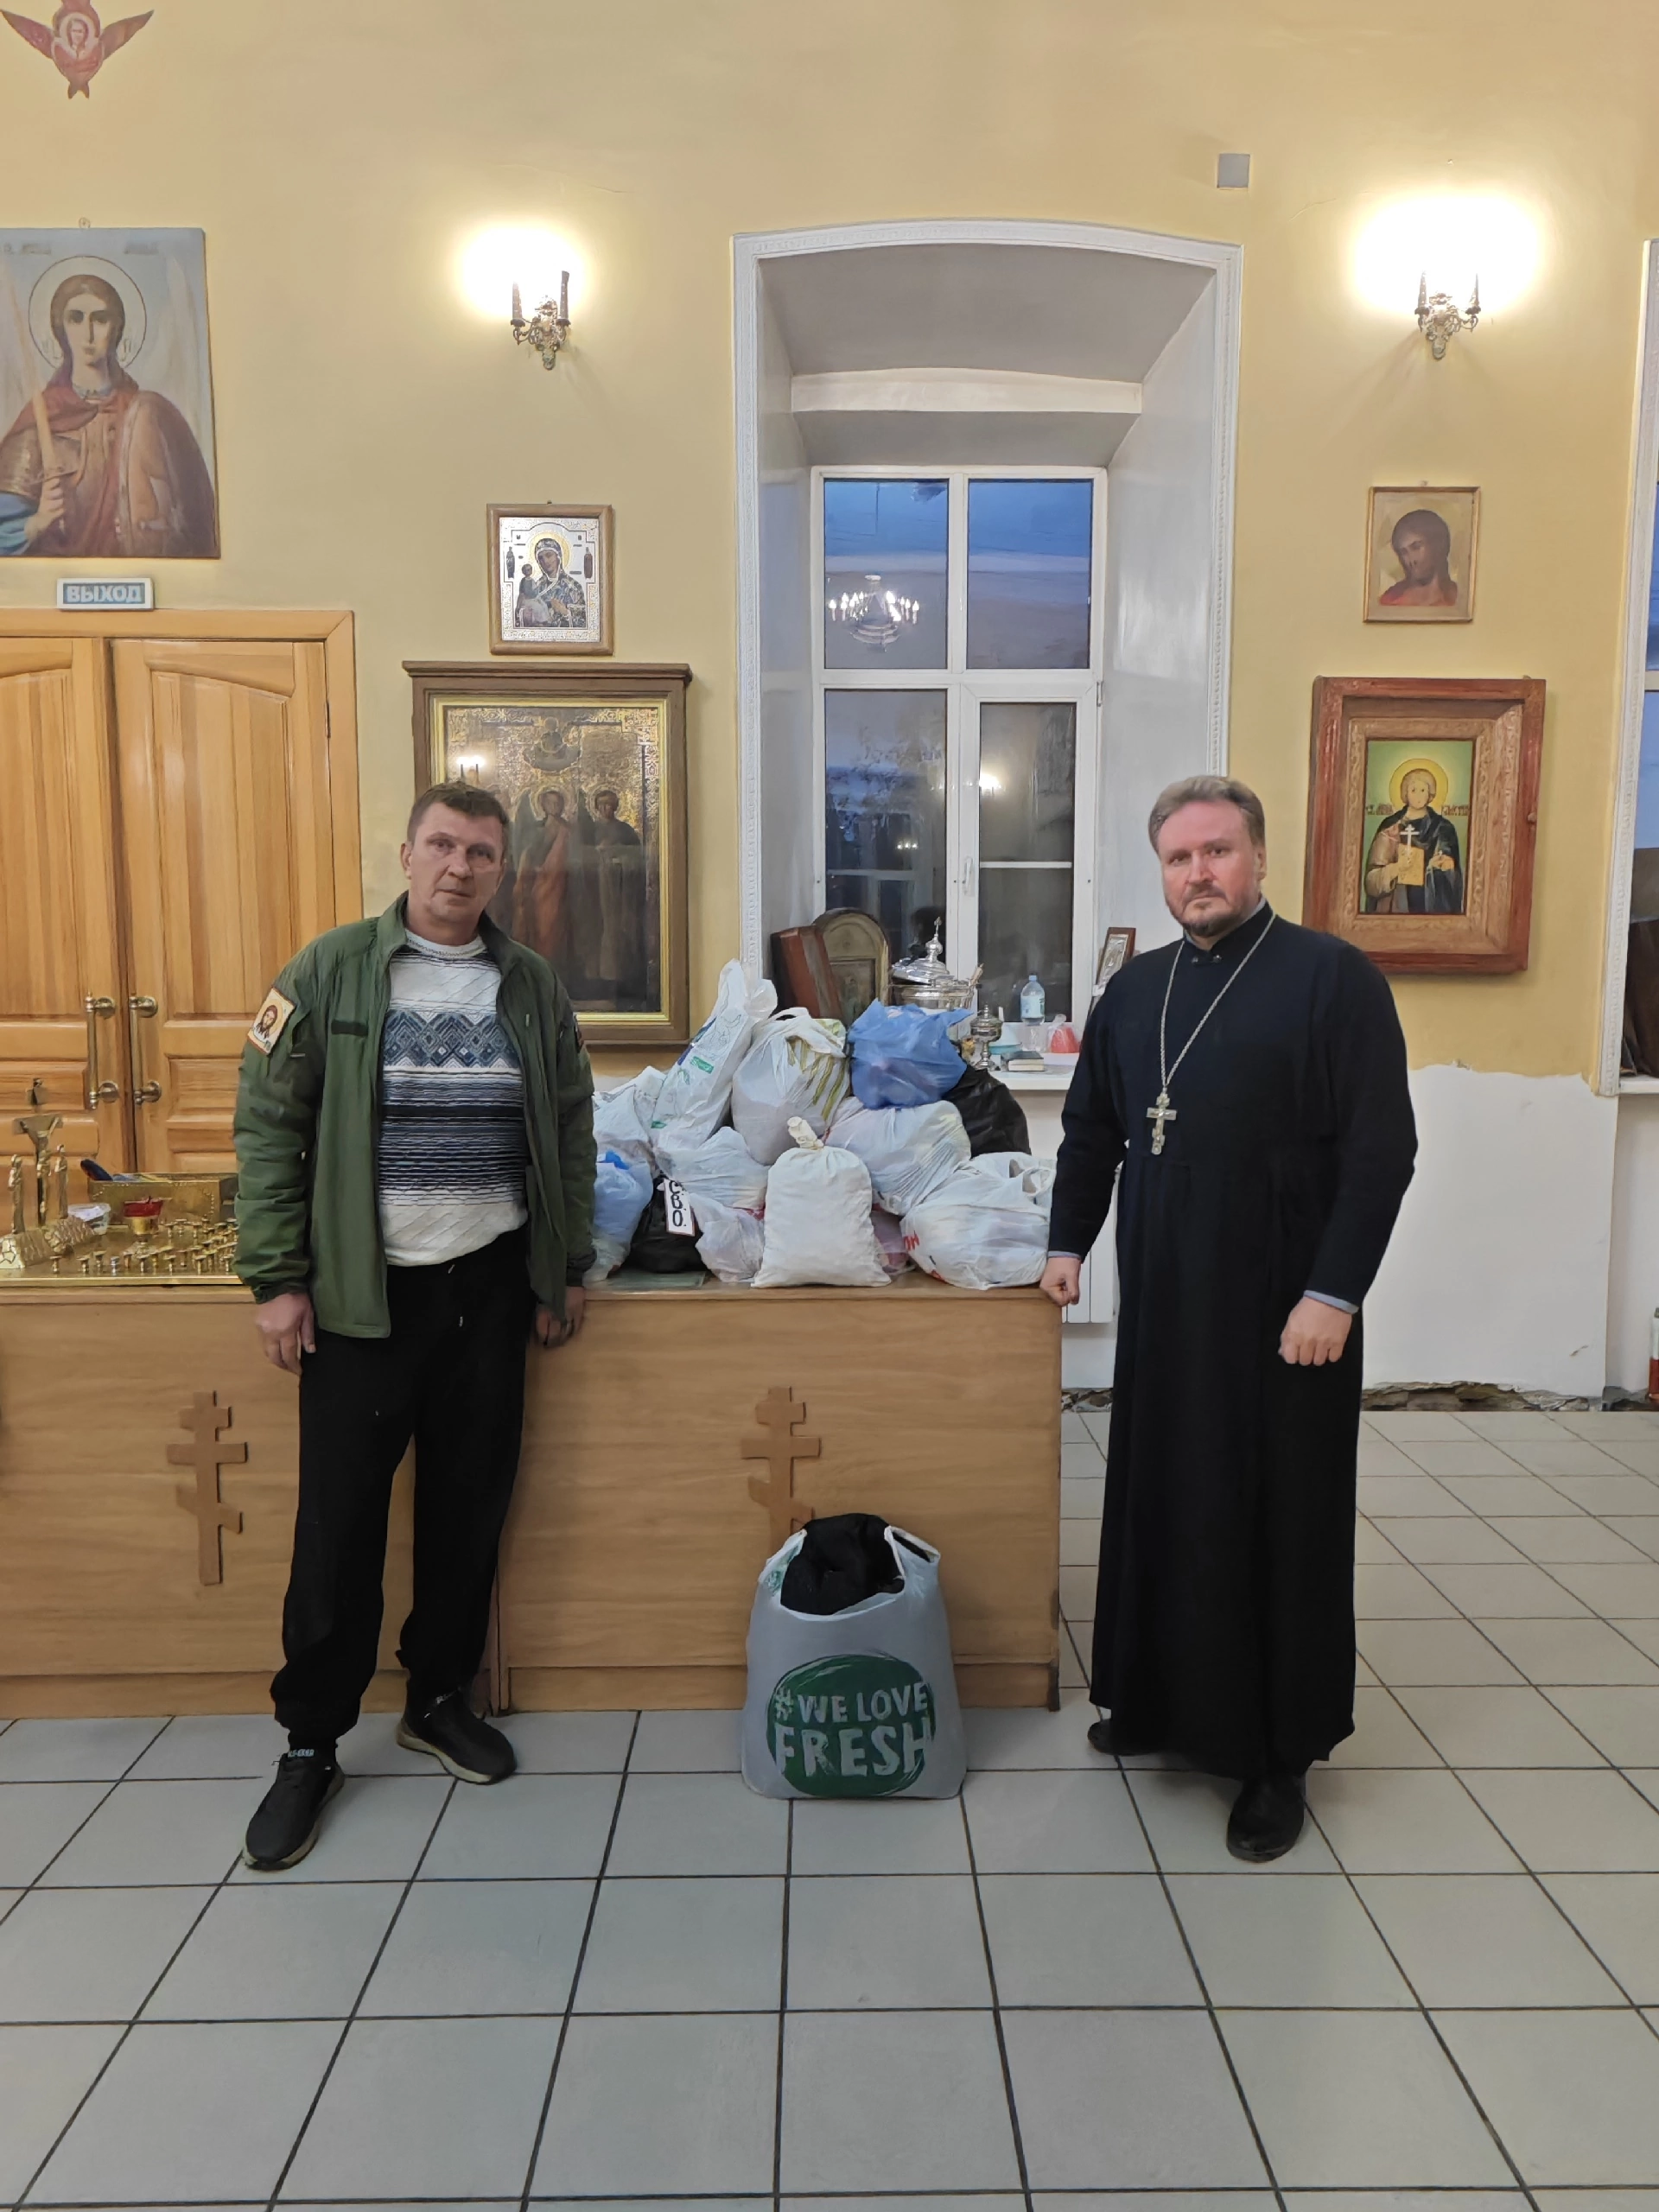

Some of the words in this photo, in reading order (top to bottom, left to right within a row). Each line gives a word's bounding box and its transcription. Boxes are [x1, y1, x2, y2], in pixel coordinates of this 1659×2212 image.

[67, 585, 142, 603] ВЫХОД
[856, 1681, 929, 1722] LOVE
[774, 1716, 932, 1777] FRESH
